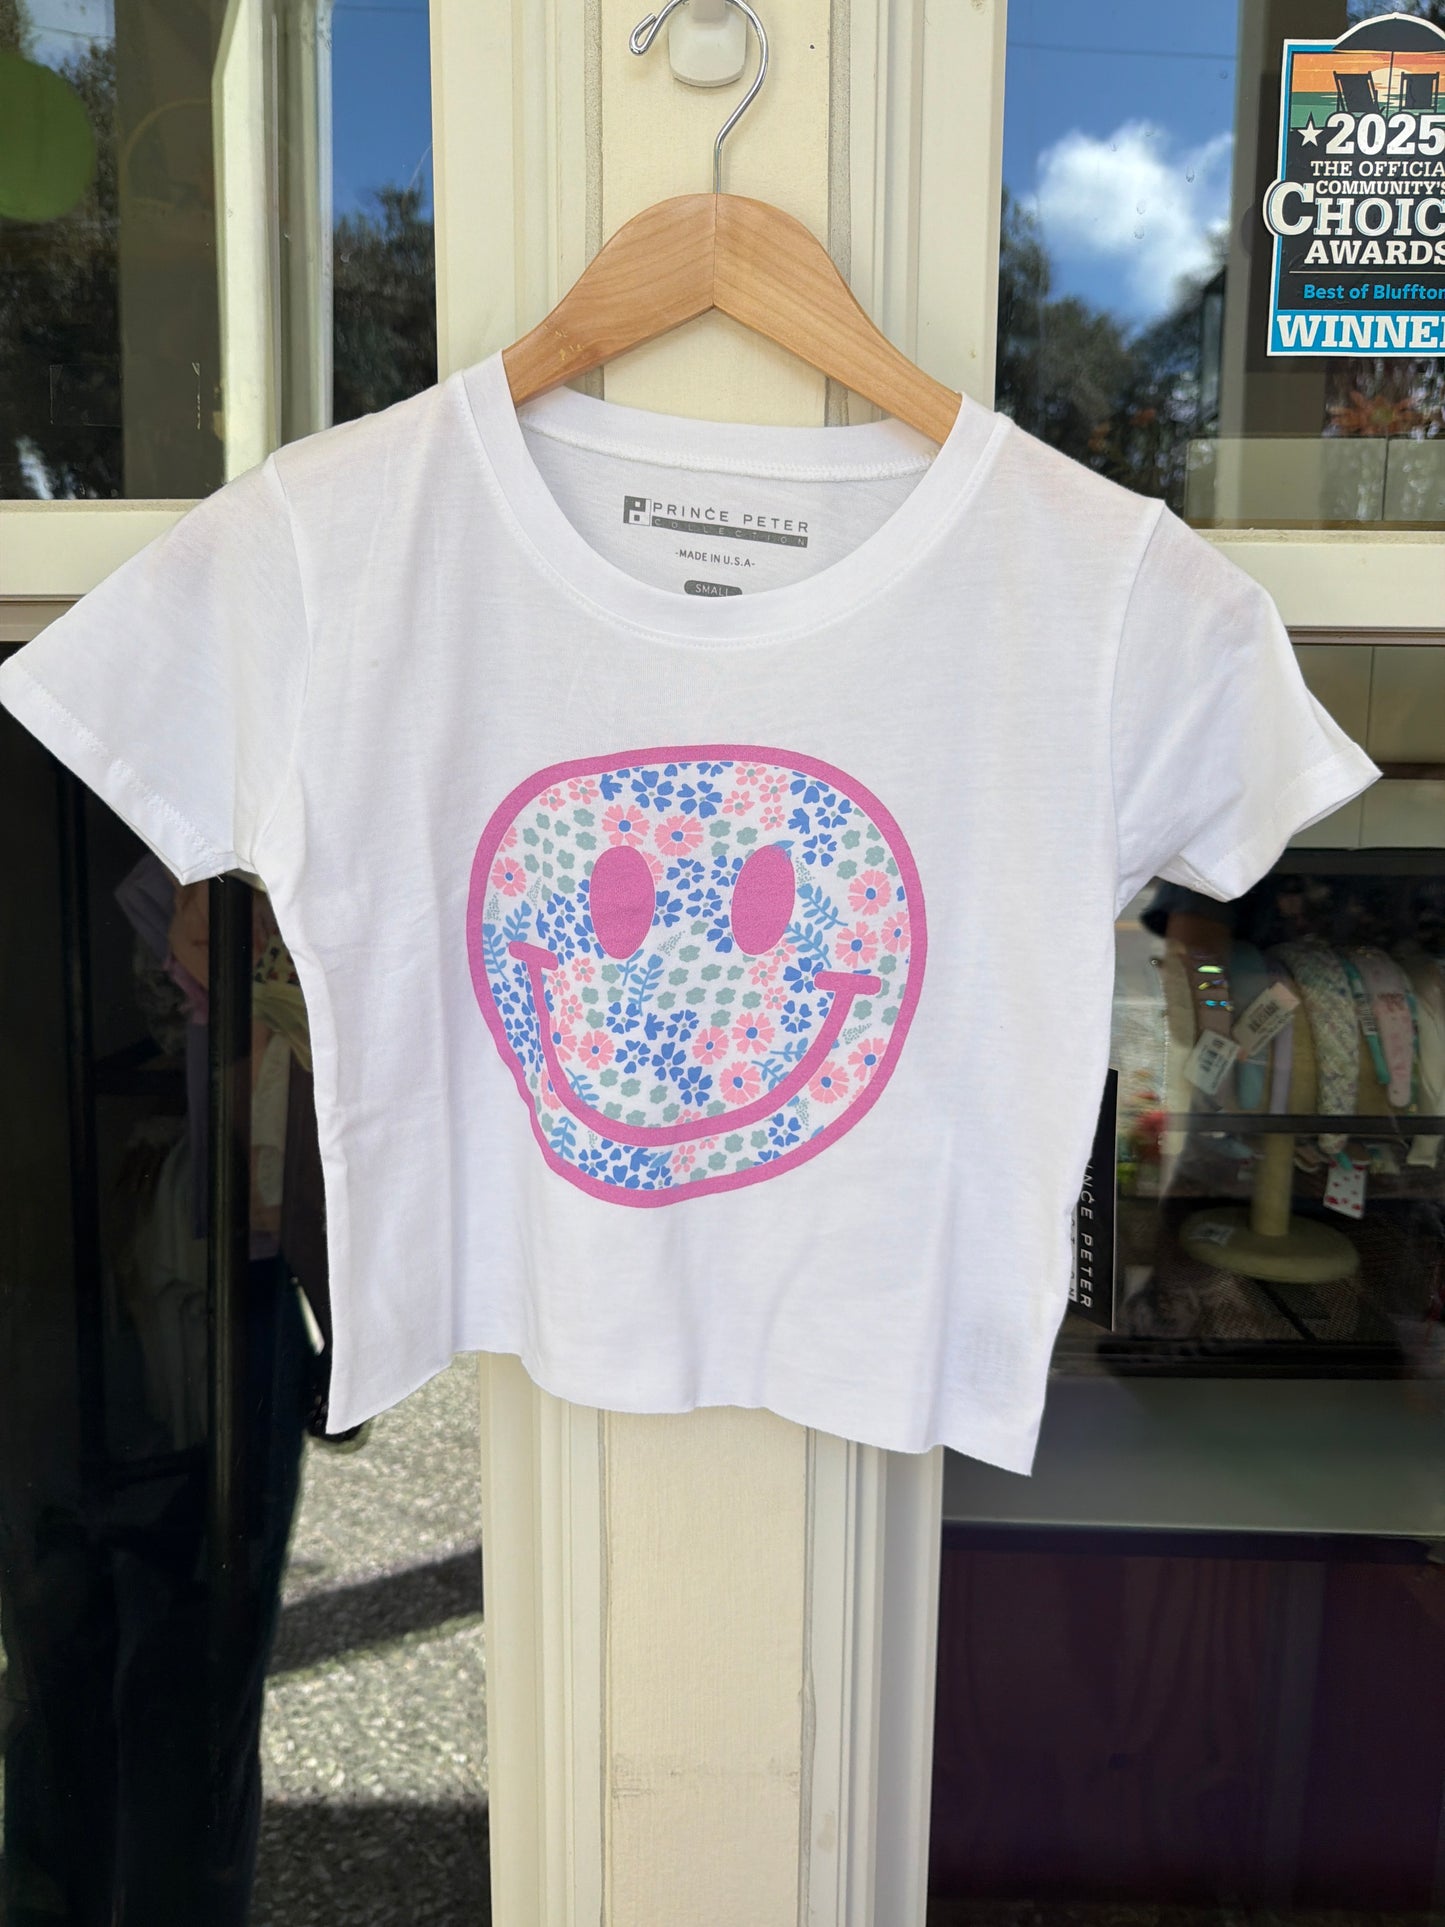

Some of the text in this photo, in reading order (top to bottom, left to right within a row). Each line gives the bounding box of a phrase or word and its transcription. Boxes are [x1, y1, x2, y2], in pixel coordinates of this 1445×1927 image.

[1326, 113, 1445, 156] 2025
[1310, 160, 1353, 177] THE
[1303, 239, 1445, 266] AWARDS
[1303, 283, 1345, 299] Best
[1349, 283, 1370, 299] of
[1276, 314, 1445, 349] WINNE
[654, 518, 806, 546] COLLECTION
[742, 513, 809, 534] PETER
[710, 553, 721, 563] IN
[1080, 1232, 1094, 1309] PETER
